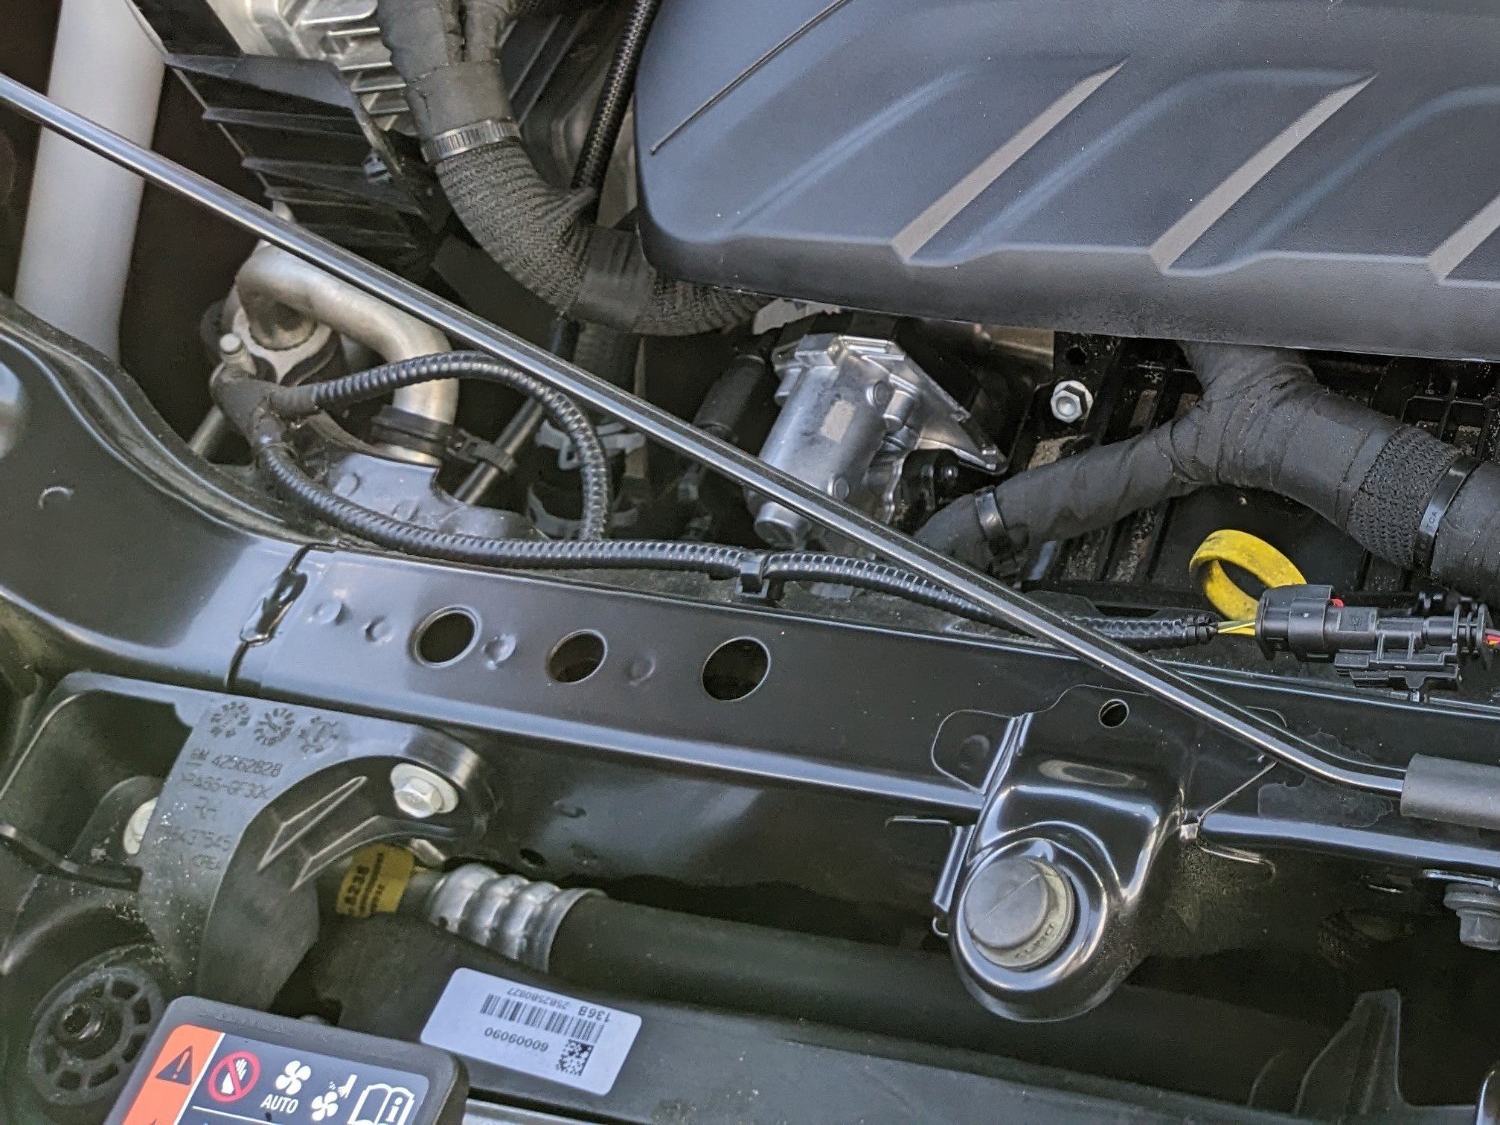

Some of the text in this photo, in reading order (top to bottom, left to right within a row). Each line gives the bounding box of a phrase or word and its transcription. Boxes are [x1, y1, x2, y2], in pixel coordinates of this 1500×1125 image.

[577, 1005, 612, 1024] 136B
[484, 1026, 549, 1053] 60009090
[260, 1093, 299, 1114] AUTO
